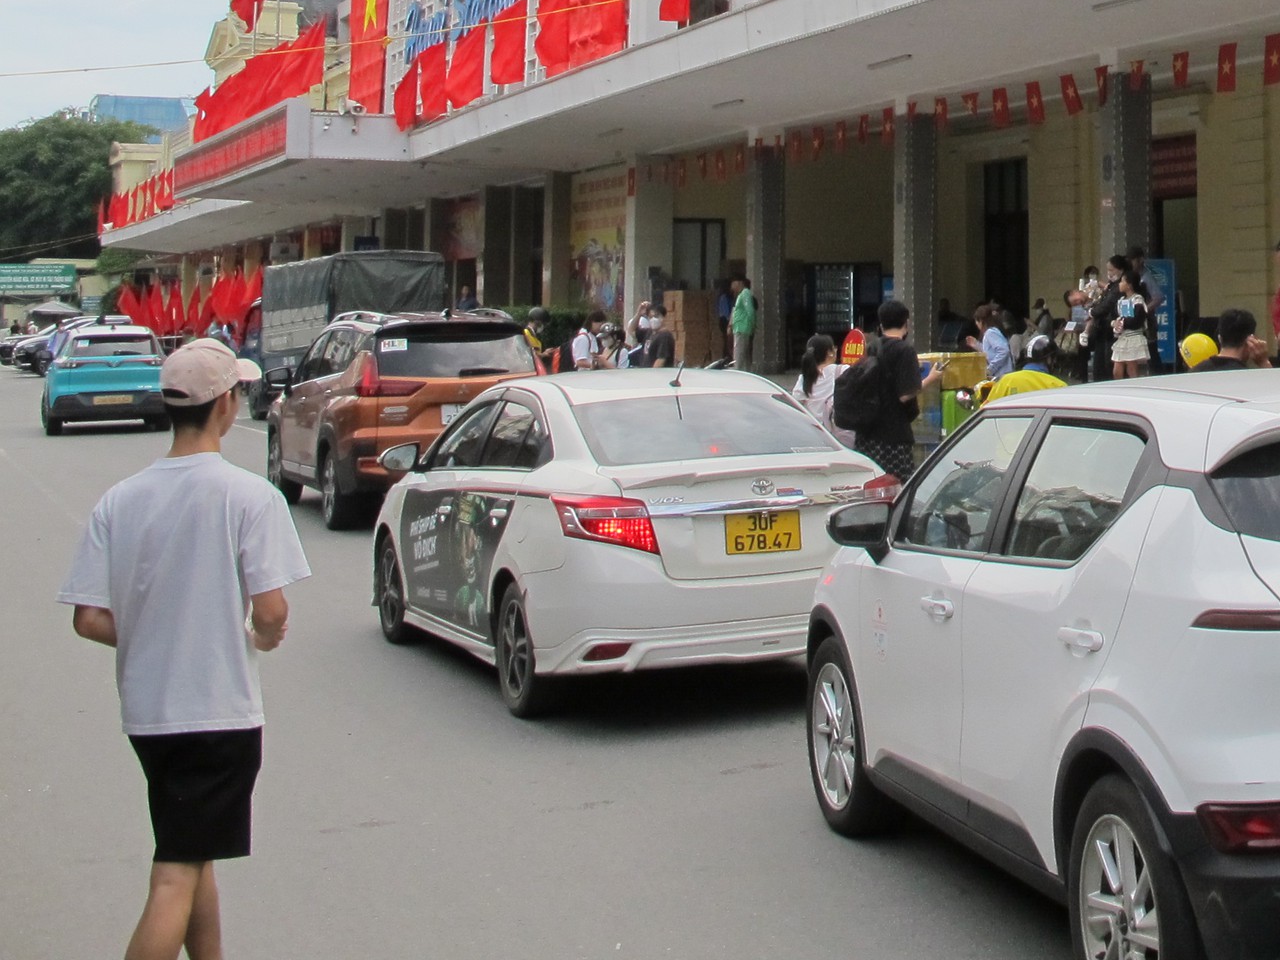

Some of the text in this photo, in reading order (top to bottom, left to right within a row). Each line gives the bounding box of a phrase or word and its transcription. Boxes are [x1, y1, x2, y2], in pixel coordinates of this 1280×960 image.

[648, 495, 685, 505] VIOS
[747, 514, 778, 532] 30F
[734, 532, 792, 552] 678.47
